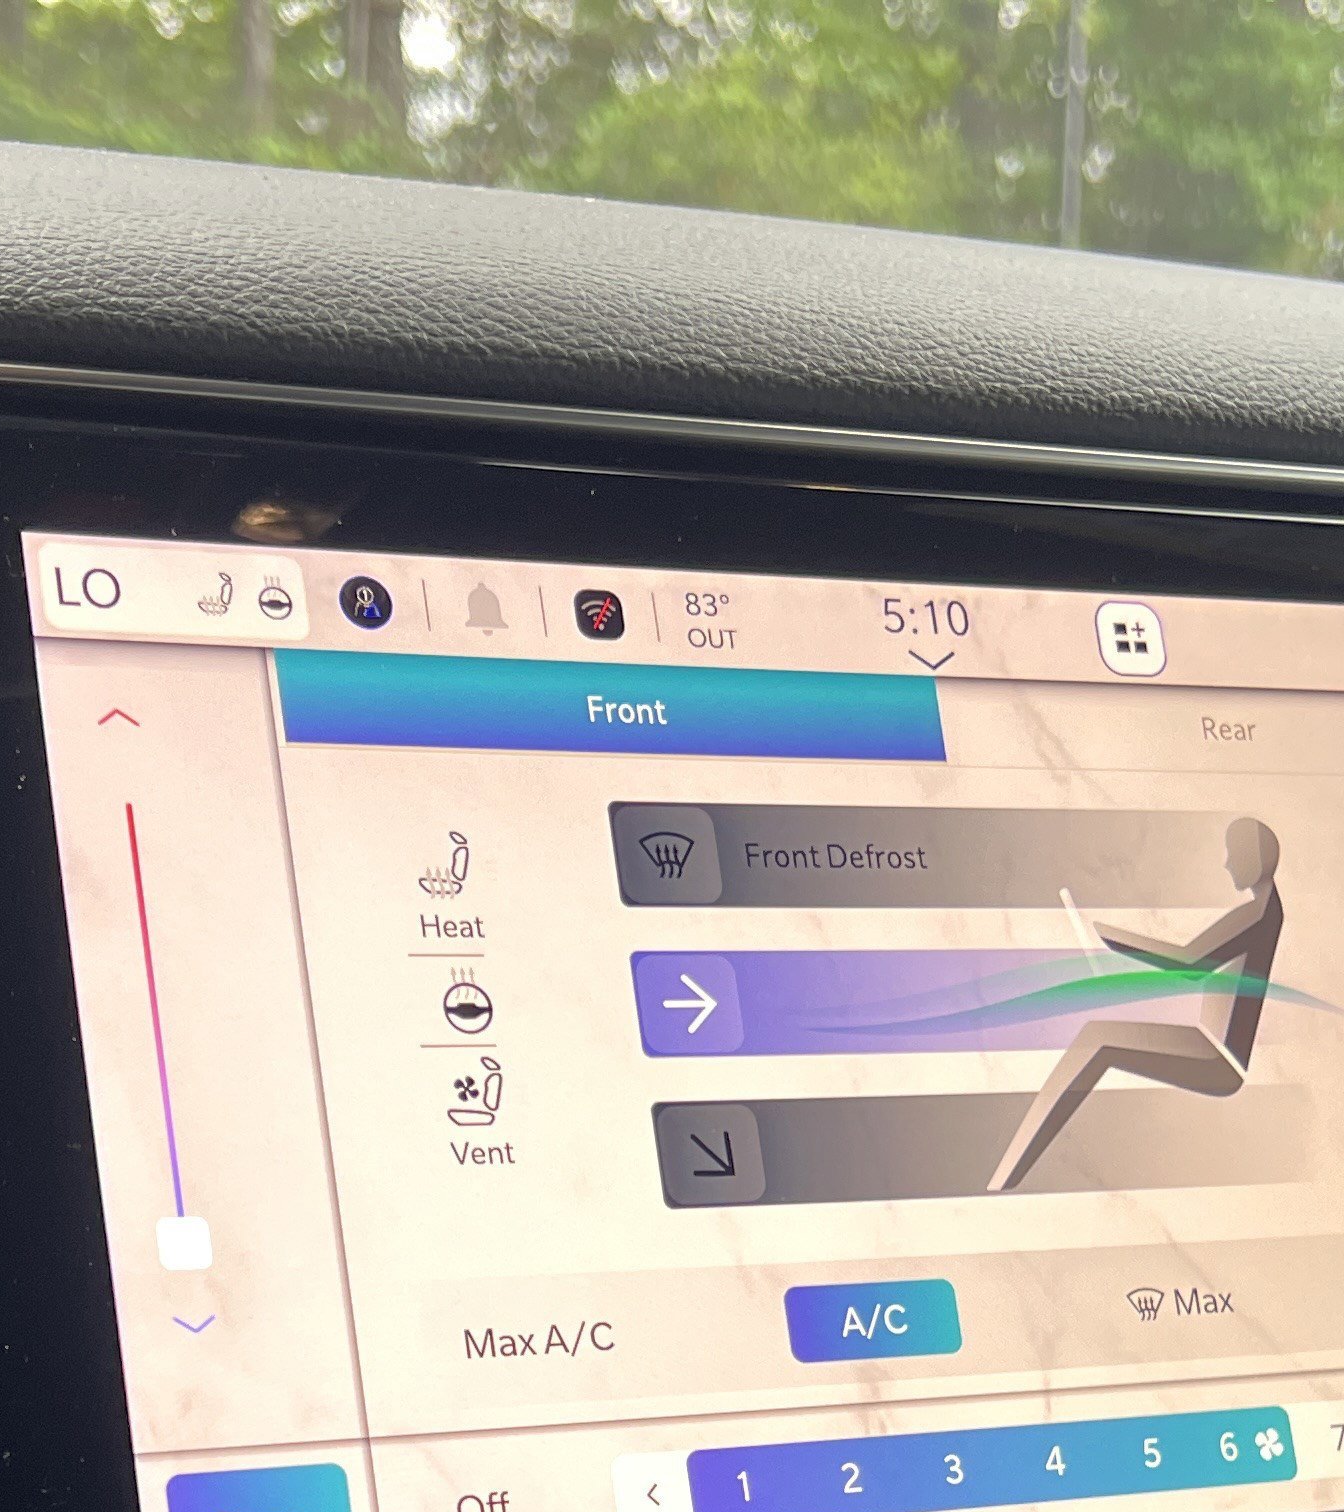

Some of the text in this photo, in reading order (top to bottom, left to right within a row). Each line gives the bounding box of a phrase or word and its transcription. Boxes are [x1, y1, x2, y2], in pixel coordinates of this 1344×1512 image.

[55, 566, 122, 609] LO
[882, 598, 970, 638] 5:10
[687, 629, 737, 650] OUT
[586, 695, 668, 726] Front
[1201, 715, 1256, 744] Rear
[743, 841, 928, 872] Front Defrost
[419, 912, 486, 941] Heat
[449, 1140, 516, 1166] Vent
[1172, 1287, 1236, 1318] Max
[841, 1304, 909, 1340] A/C
[462, 1321, 616, 1361] Max A/C
[736, 1470, 753, 1503] 1
[840, 1462, 864, 1495] 2
[943, 1454, 965, 1486] 3
[1044, 1445, 1067, 1477] 4
[1142, 1438, 1163, 1470] 5
[1218, 1431, 1240, 1463] 6
